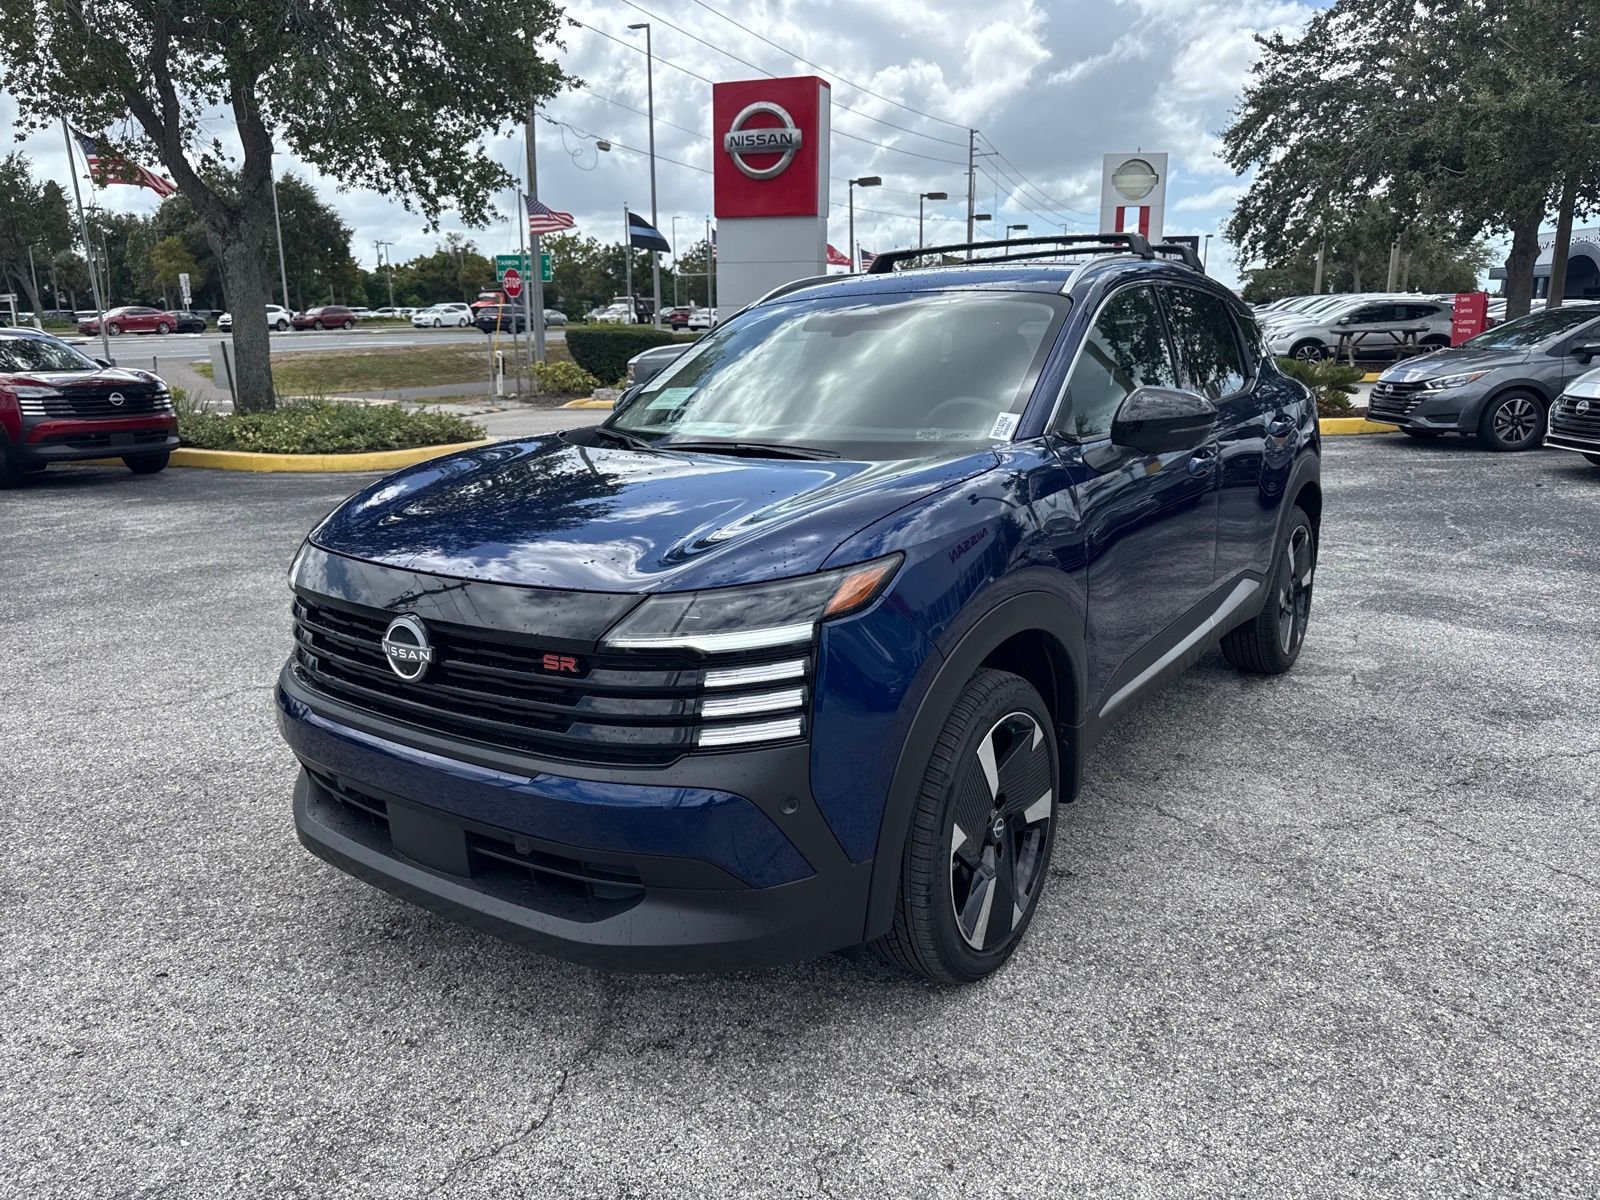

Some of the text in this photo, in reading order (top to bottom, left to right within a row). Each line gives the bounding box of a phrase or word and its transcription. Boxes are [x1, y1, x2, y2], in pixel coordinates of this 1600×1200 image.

[729, 133, 793, 148] NISSAN
[504, 276, 521, 289] STOP
[382, 643, 430, 661] NISSAN
[543, 653, 579, 673] SR
